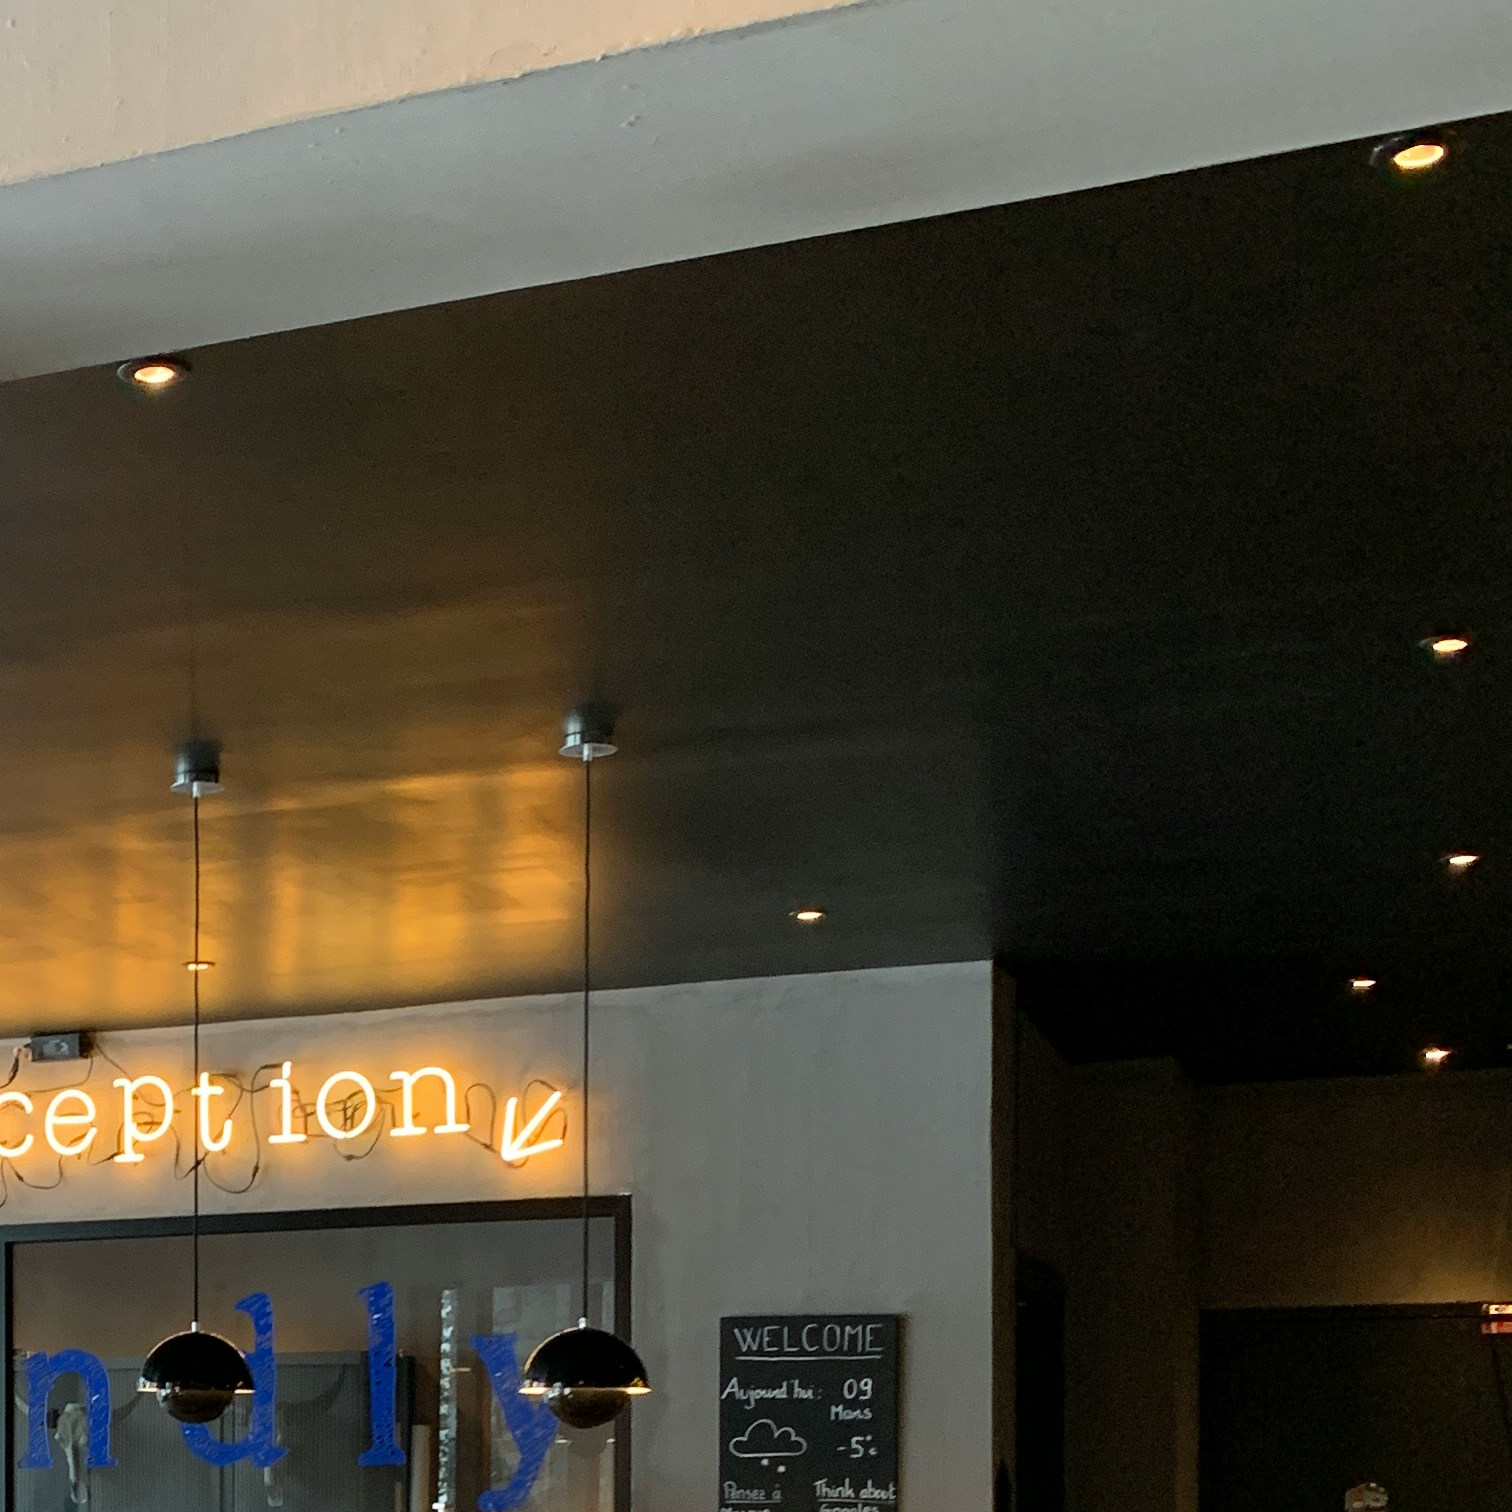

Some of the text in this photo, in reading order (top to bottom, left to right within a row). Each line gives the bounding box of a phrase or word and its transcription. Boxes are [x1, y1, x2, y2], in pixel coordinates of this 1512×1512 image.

[733, 1323, 885, 1352] WELCOME
[843, 1377, 873, 1400] 09
[813, 1478, 896, 1500] Think about
